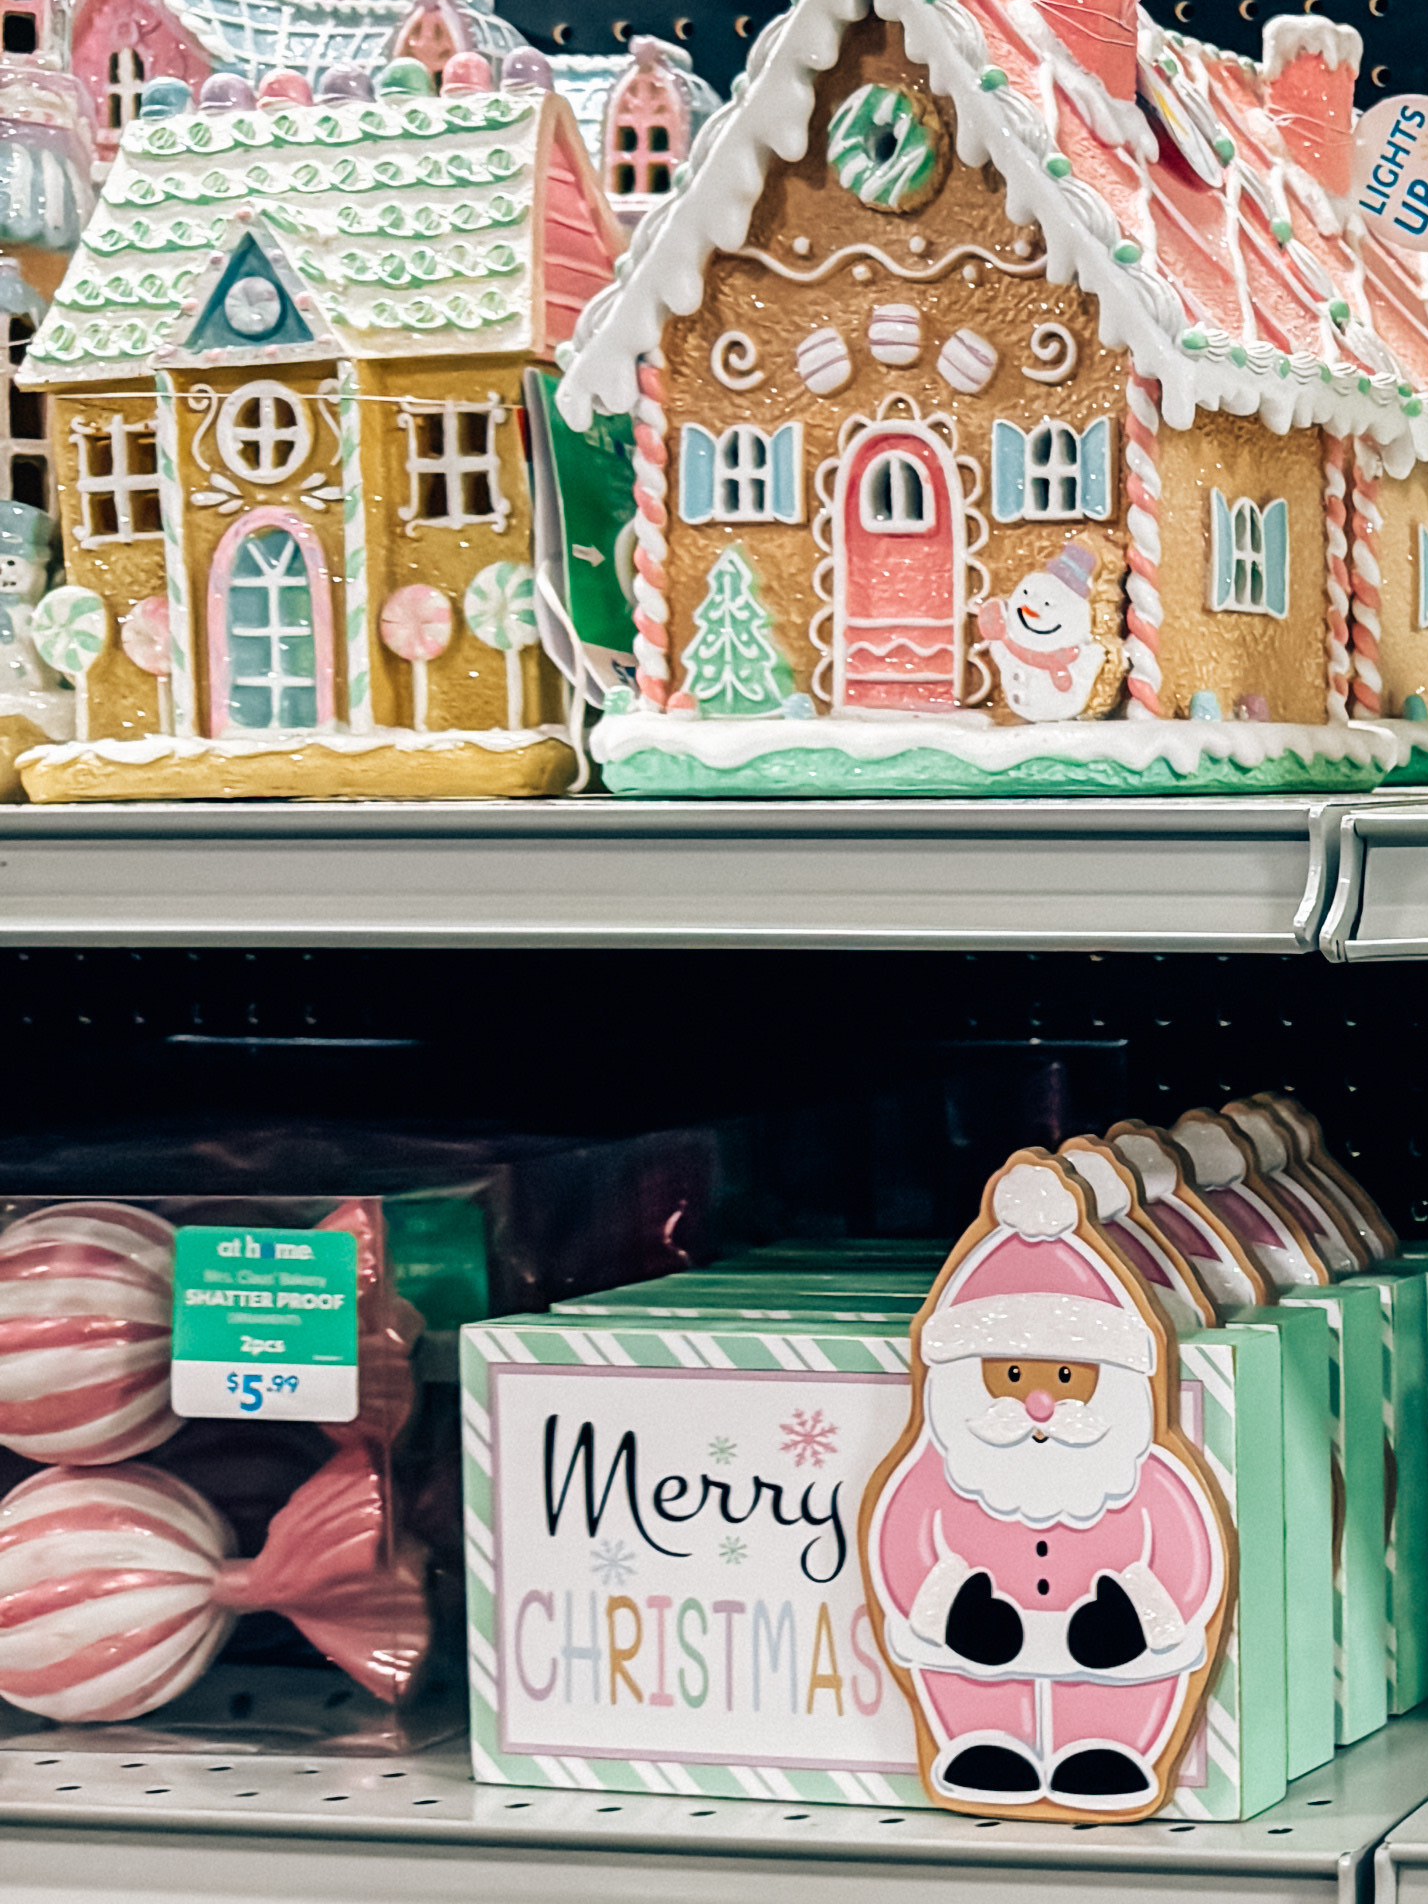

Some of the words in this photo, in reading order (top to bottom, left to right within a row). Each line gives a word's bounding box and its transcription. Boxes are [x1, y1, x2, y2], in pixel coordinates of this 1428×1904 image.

[1358, 104, 1426, 216] LIGHTS
[216, 1238, 242, 1258] at
[185, 1289, 274, 1308] SHATTER
[276, 1291, 346, 1311] PROOF
[239, 1335, 286, 1357] 2pcs
[226, 1372, 300, 1413] $5.99
[544, 1413, 848, 1584] Merry
[514, 1589, 883, 1717] CHRISTMAS
